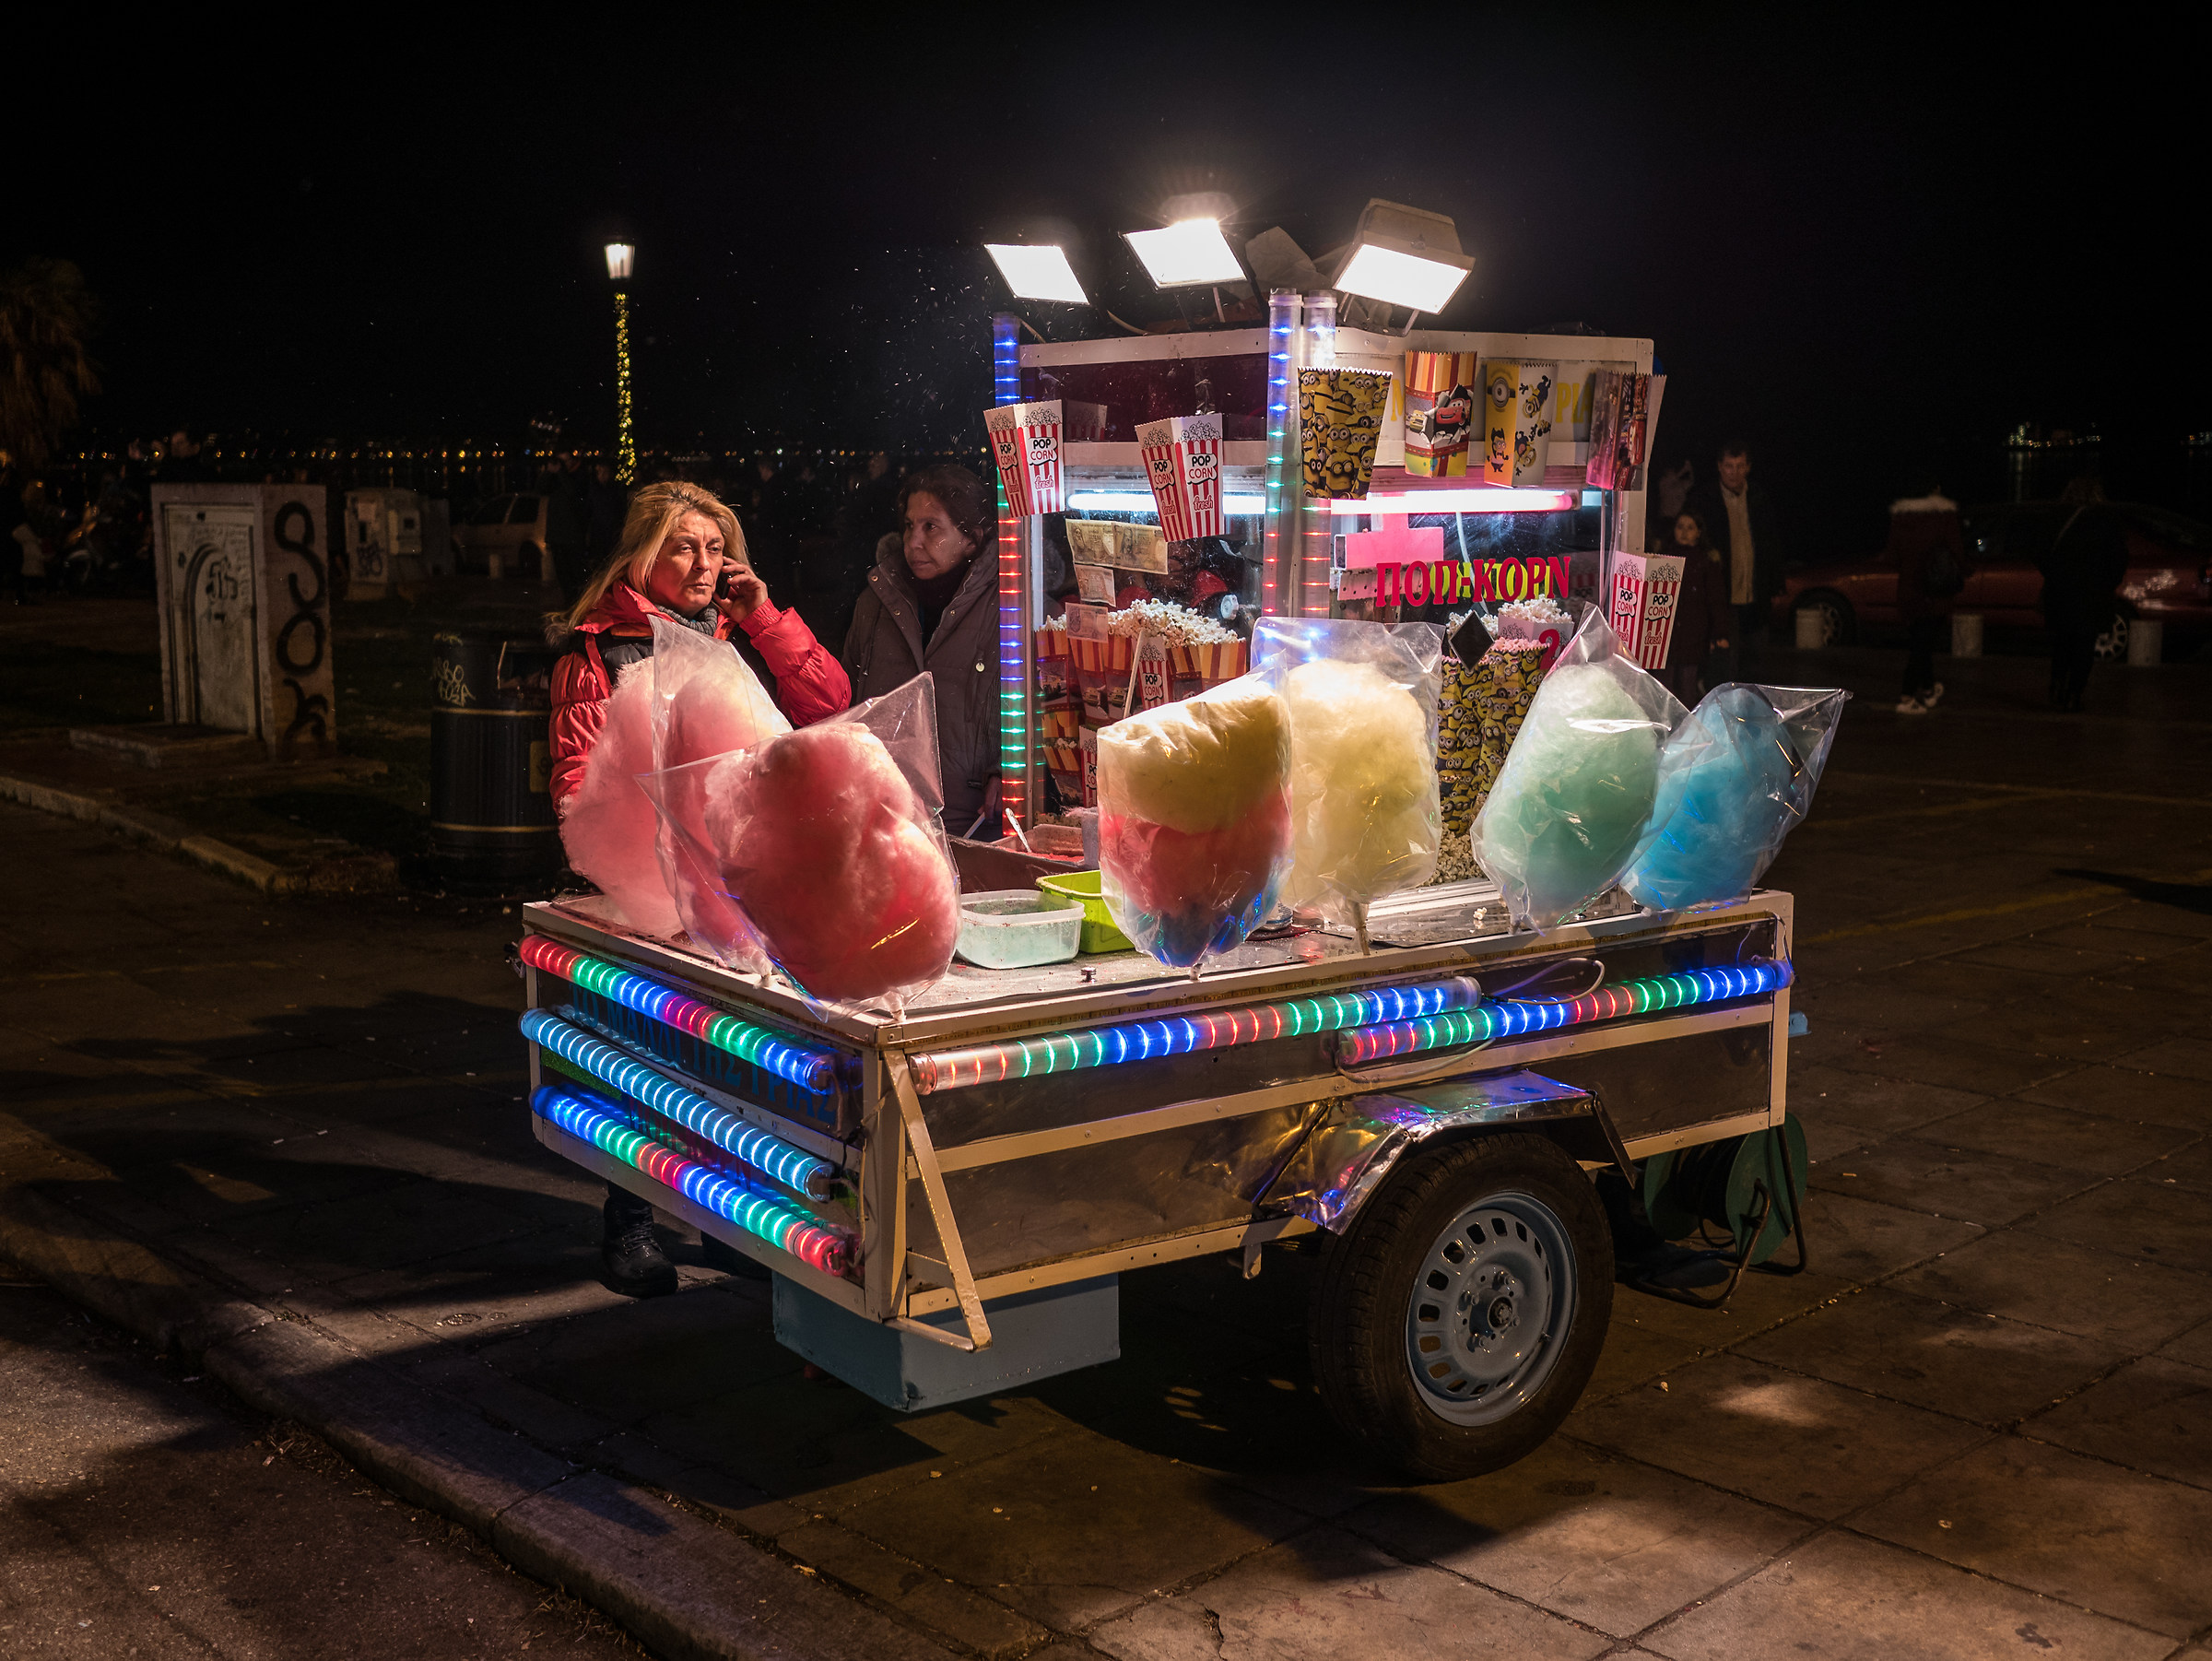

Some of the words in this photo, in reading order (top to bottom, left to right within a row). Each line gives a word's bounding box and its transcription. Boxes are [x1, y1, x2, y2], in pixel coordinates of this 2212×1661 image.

[1000, 443, 1012, 454] POP
[1033, 439, 1051, 449] POP
[1001, 455, 1016, 465] CORN
[1030, 450, 1053, 460] CORN
[1192, 455, 1211, 466] POP
[1154, 462, 1168, 473] POP
[1189, 467, 1213, 478] CORN
[1035, 475, 1053, 489] fresh
[1154, 473, 1171, 484] CORN
[1194, 495, 1213, 511] fresh
[1620, 590, 1633, 602] POP
[1653, 595, 1669, 605] POP
[1618, 600, 1632, 613] CORN
[1648, 607, 1668, 616] CORN
[1146, 675, 1158, 685] POP
[1145, 687, 1160, 696] CORN
